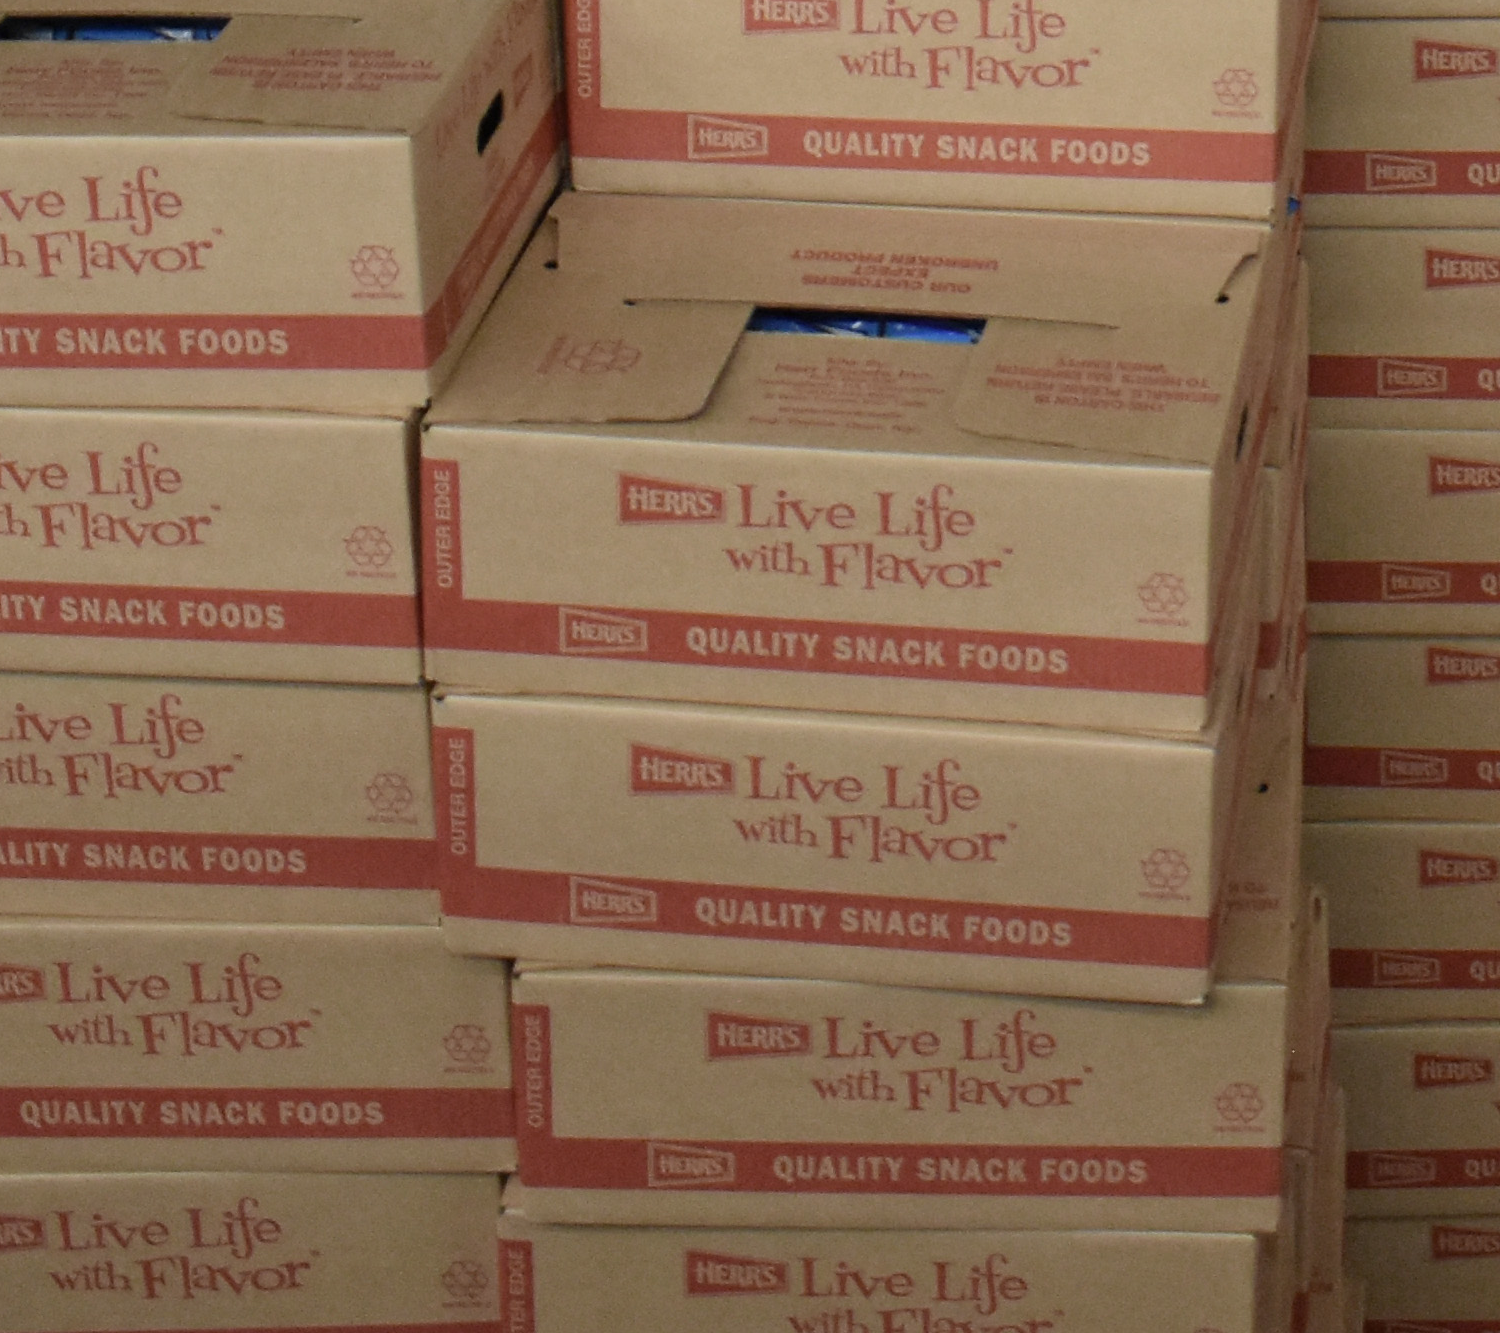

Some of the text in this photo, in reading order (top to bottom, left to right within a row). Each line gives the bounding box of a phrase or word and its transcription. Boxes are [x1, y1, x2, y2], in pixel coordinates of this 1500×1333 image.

[577, 37, 592, 97] OUTER
[840, 47, 1088, 91] with Flavor
[803, 131, 924, 158] QUALITY
[937, 134, 1038, 162] SNACK
[1051, 137, 1151, 165] FOODS
[449, 738, 468, 854] OUTER EDGE
[743, 755, 864, 803] Live
[881, 758, 981, 825] Life
[733, 813, 1007, 864] with Flavor
[695, 897, 825, 930] QUALITY
[840, 907, 950, 940] SNACK
[962, 912, 1072, 946] FOODS
